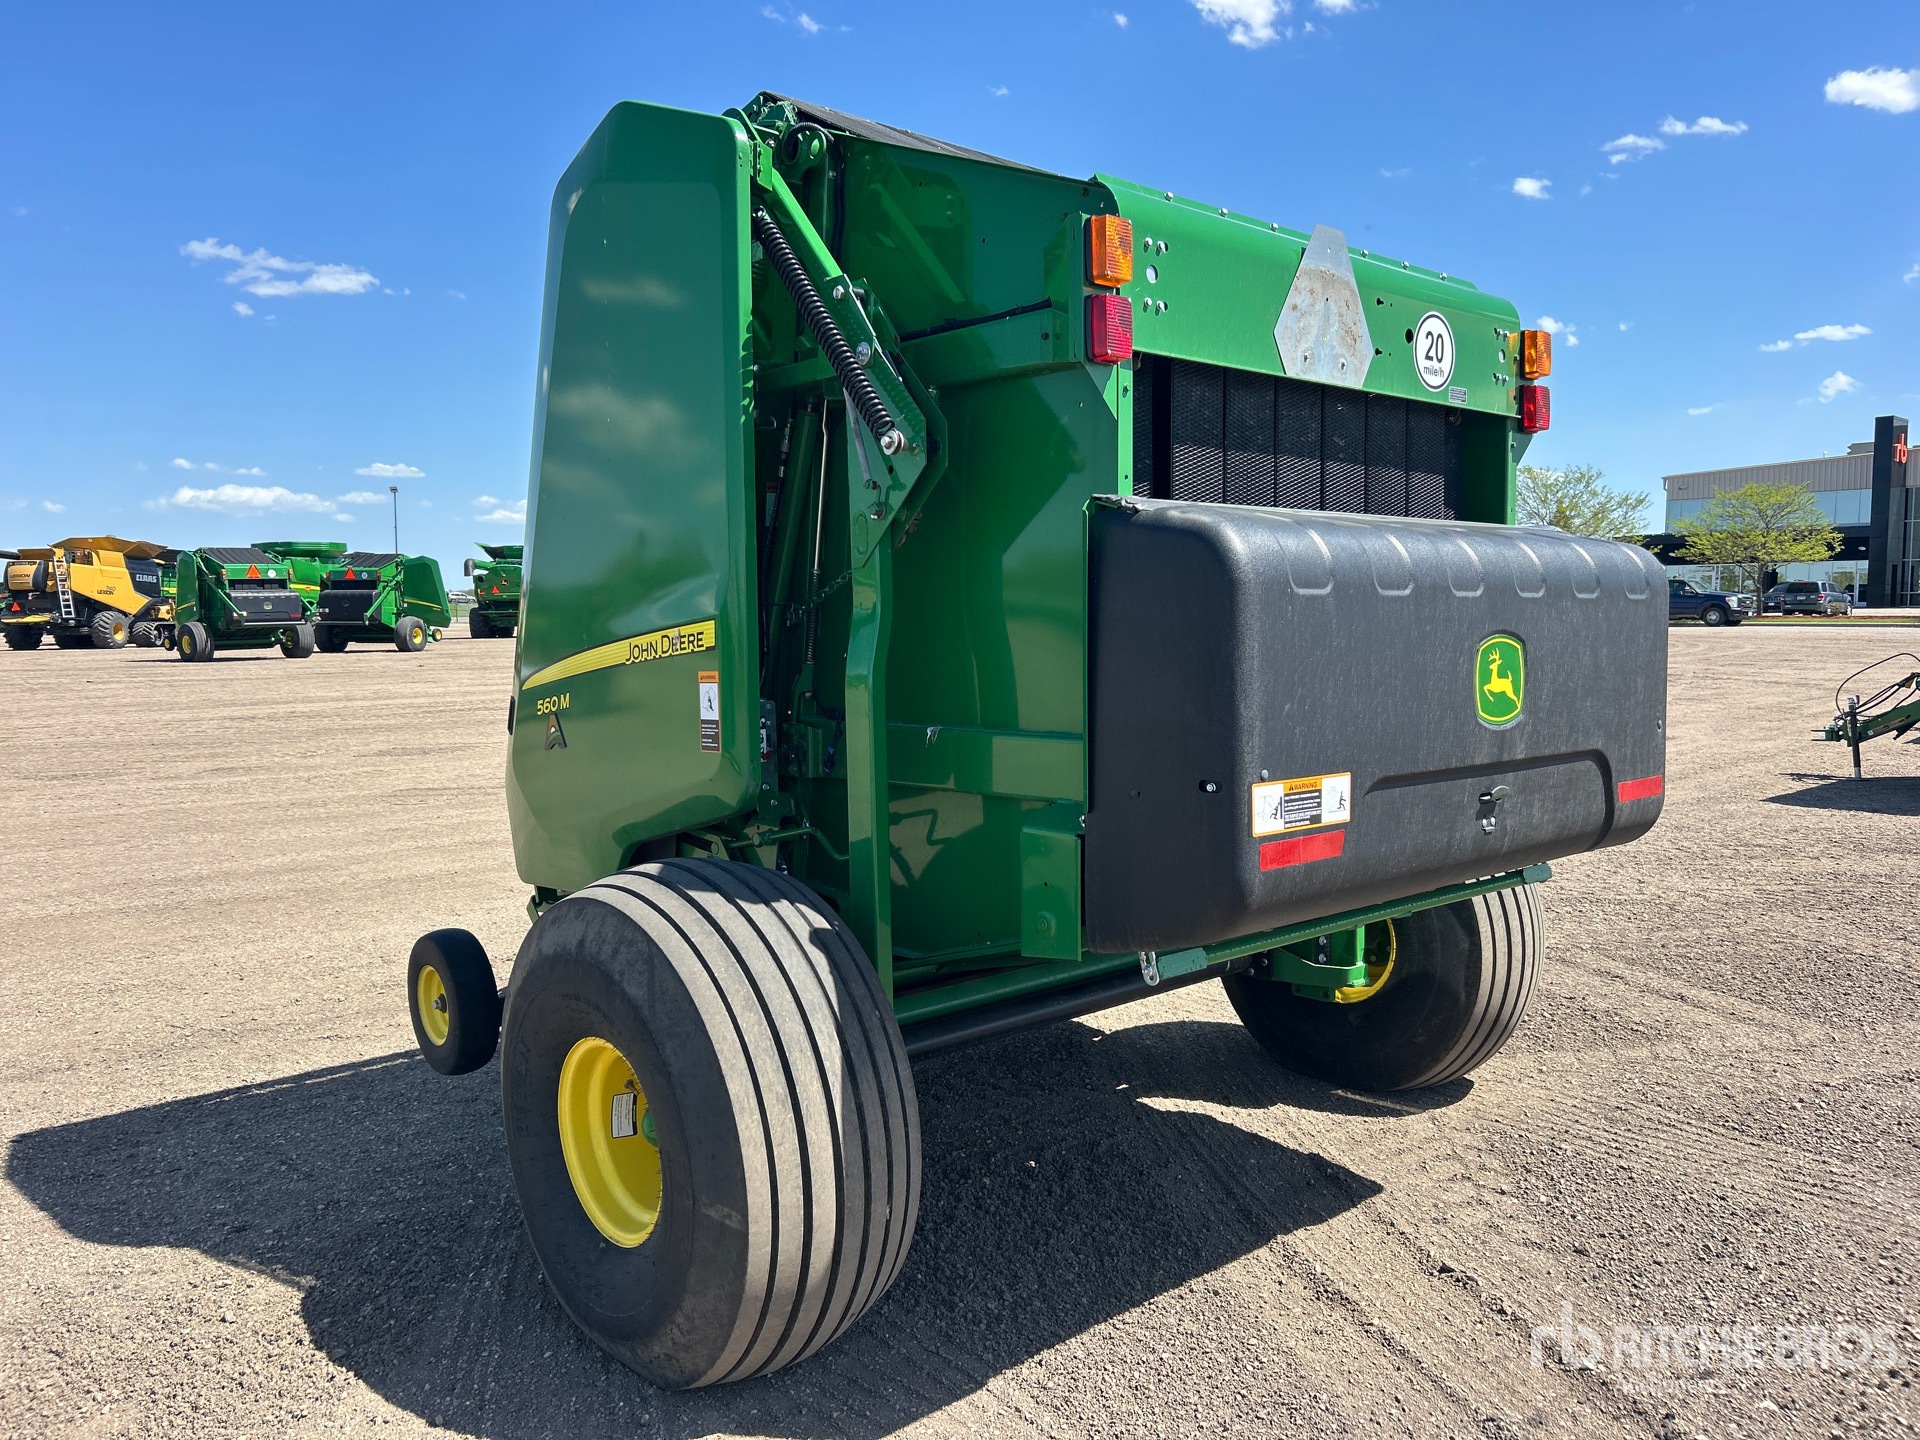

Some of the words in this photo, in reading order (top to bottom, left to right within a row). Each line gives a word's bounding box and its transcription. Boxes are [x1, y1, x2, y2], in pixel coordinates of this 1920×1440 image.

[1424, 331, 1445, 364] 20
[1423, 365, 1445, 378] mile/h
[135, 574, 157, 583] CLAAS
[625, 639, 659, 662] JOHN
[661, 631, 705, 655] DEERE
[537, 695, 559, 716] 560
[560, 692, 570, 710] M
[1294, 782, 1318, 791] WARNING
